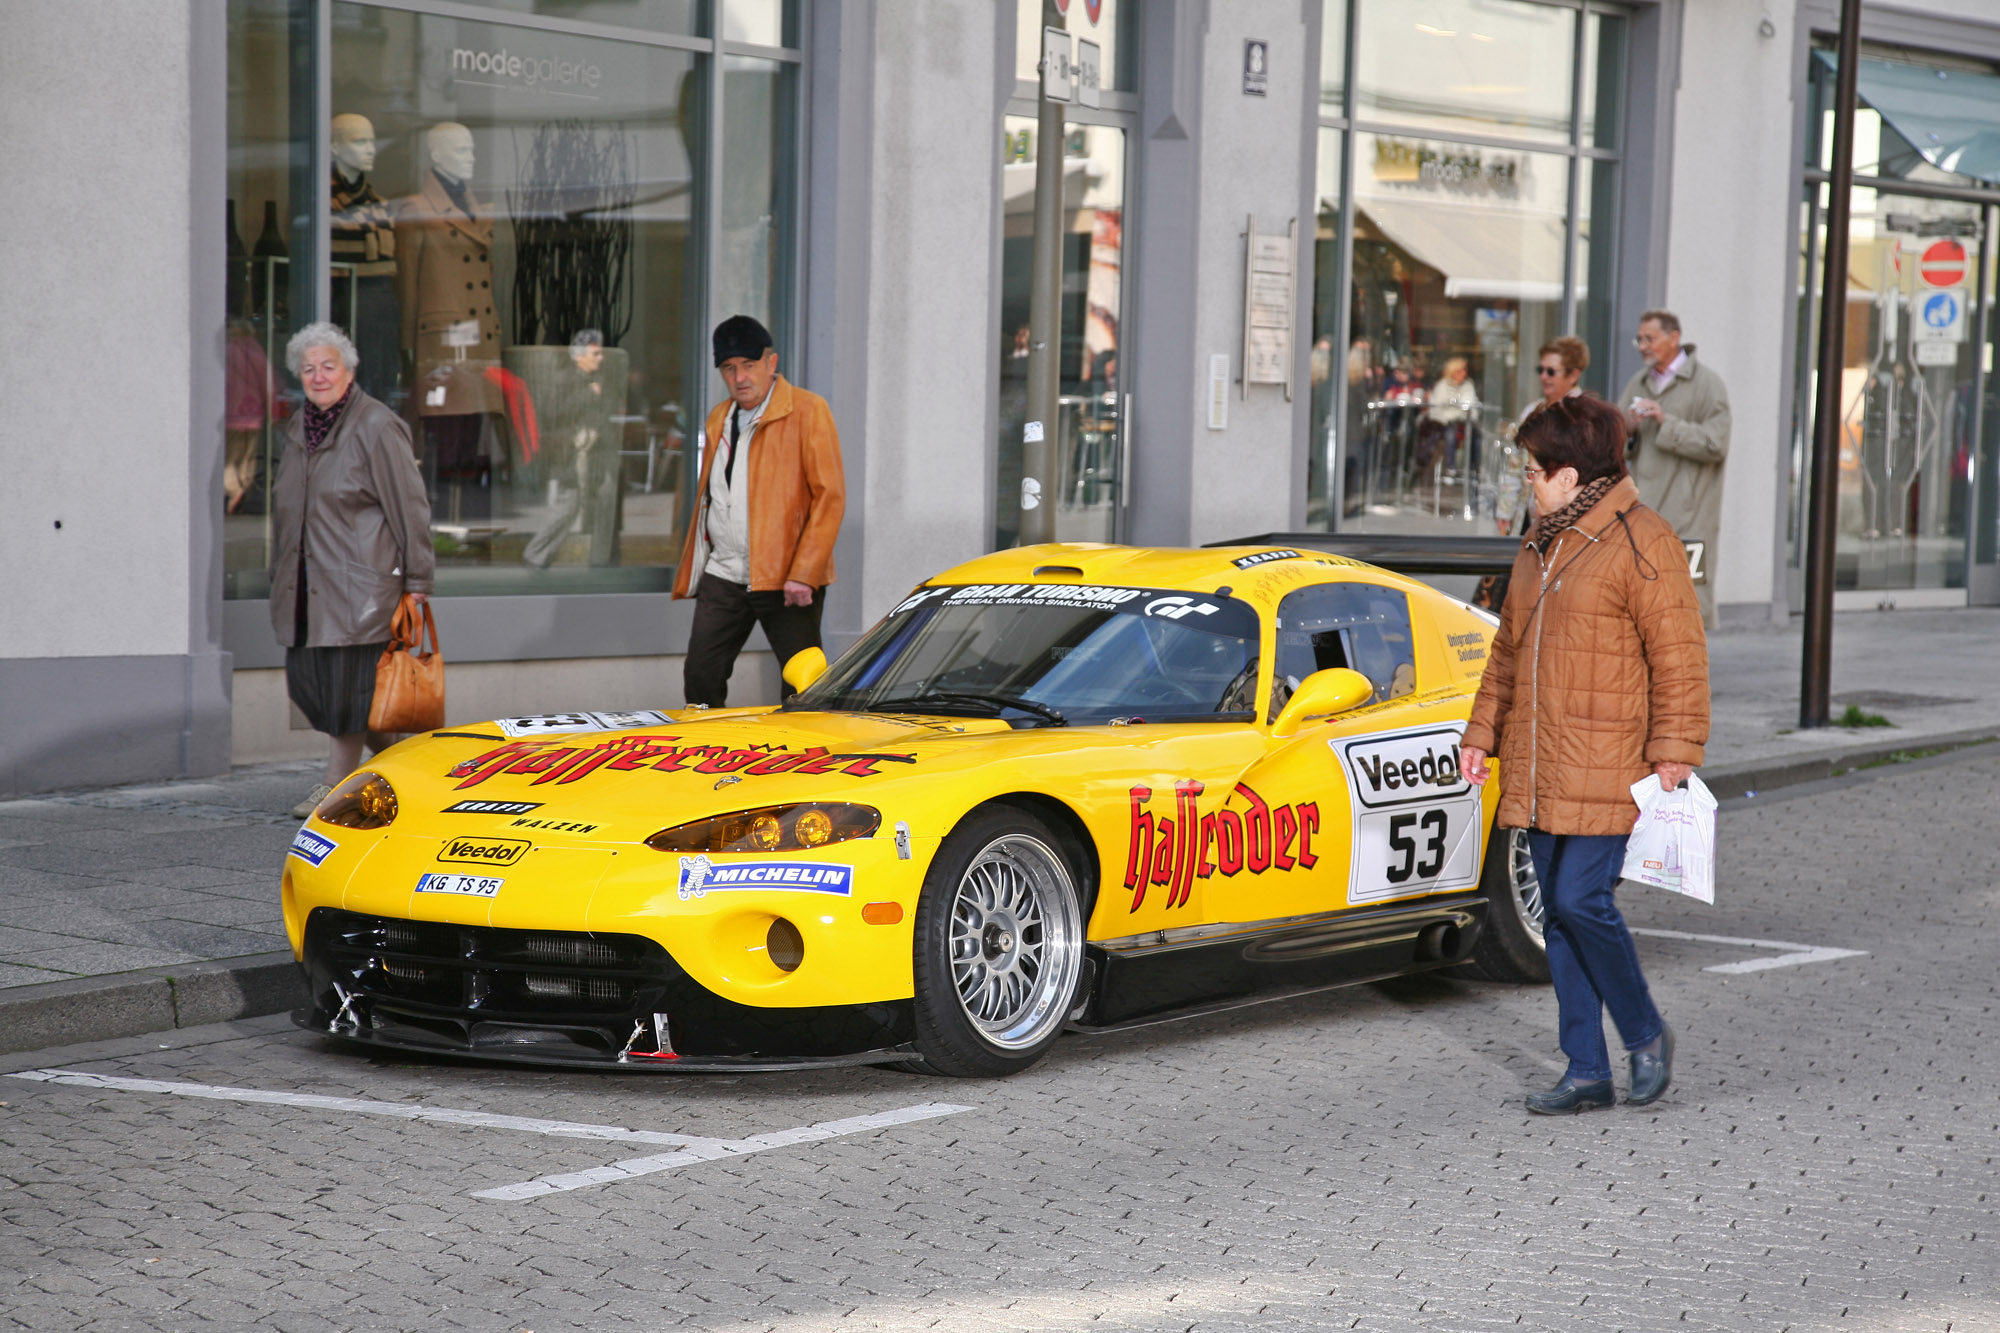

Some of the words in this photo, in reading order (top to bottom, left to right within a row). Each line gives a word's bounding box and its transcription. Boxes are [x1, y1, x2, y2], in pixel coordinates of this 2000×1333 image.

[452, 47, 601, 88] modegalerie
[1237, 550, 1298, 567] KRAFFT
[950, 584, 1031, 600] GRAN
[1045, 599, 1117, 610] SIMULATOR
[1446, 631, 1485, 648] Unigraphics
[1457, 647, 1486, 662] Solutions
[1356, 743, 1462, 792] Veedol
[452, 801, 537, 814] KRAFFT
[510, 818, 598, 833] WALZEN
[448, 842, 522, 861] Veedol
[1386, 808, 1448, 884] 53
[1644, 861, 1661, 869] NEU
[427, 875, 450, 890] KG
[455, 877, 476, 892] TS
[477, 879, 498, 895] 95
[712, 867, 846, 886] MICHELIN
